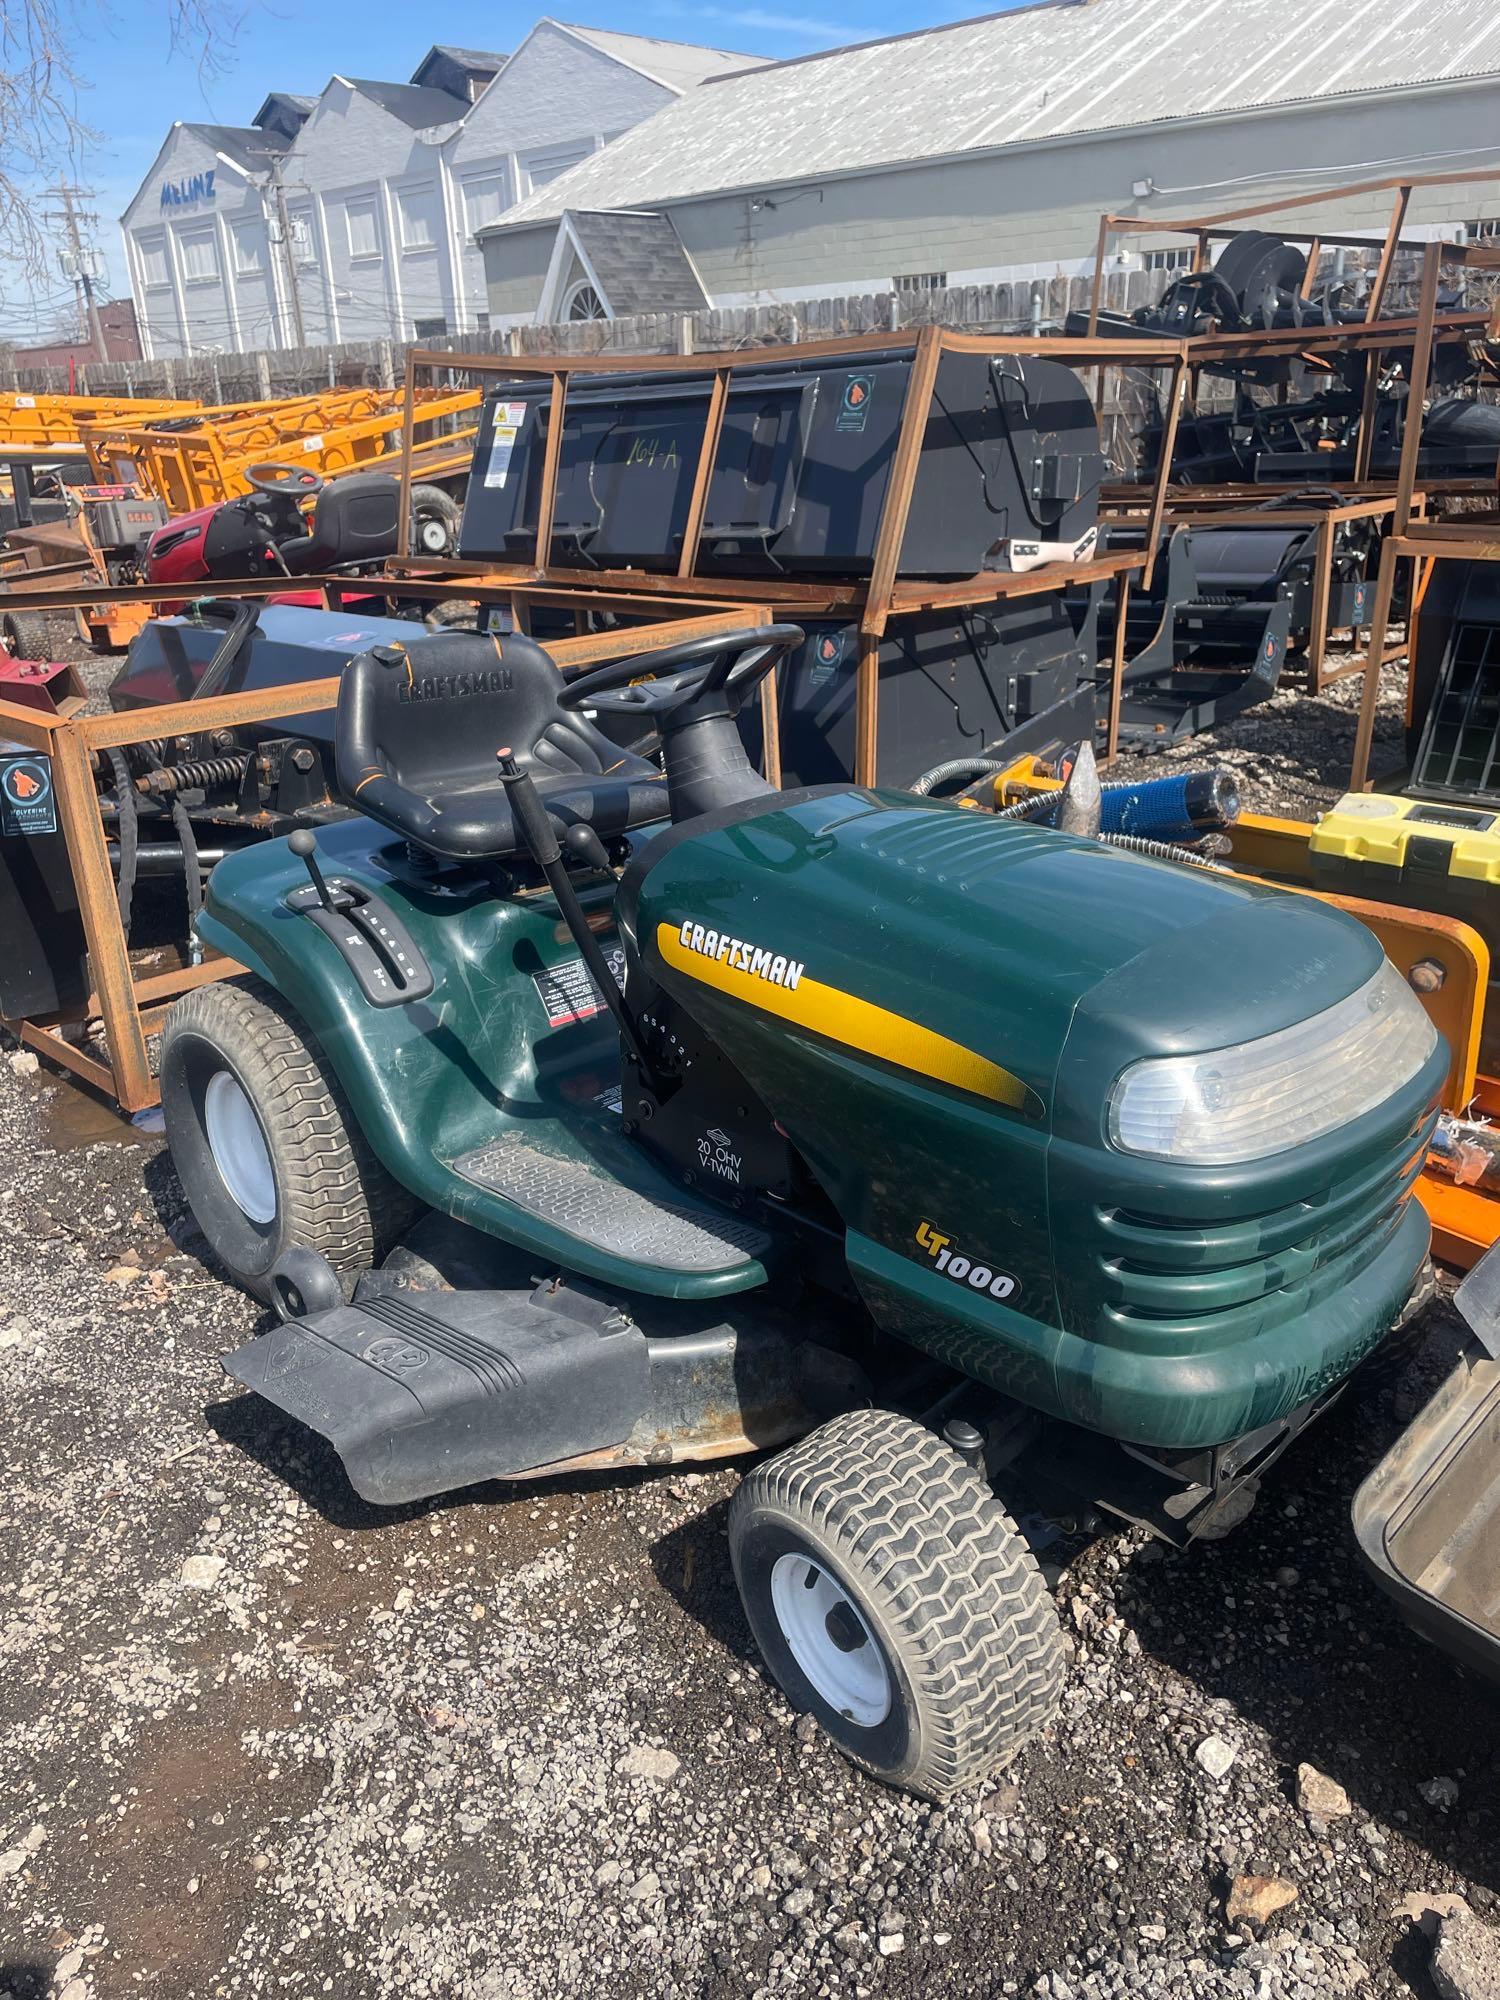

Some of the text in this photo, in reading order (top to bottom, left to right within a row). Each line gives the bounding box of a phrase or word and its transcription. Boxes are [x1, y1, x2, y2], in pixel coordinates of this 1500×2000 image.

[398, 669, 514, 704] CRAFTSMAN
[680, 920, 804, 991] CRAFTSMAN
[697, 1138, 742, 1169] 20 OHV
[699, 1152, 740, 1184] V-TWIN
[915, 1221, 950, 1257] LT
[935, 1248, 1015, 1298] 1000
[369, 1343, 421, 1376] 42
